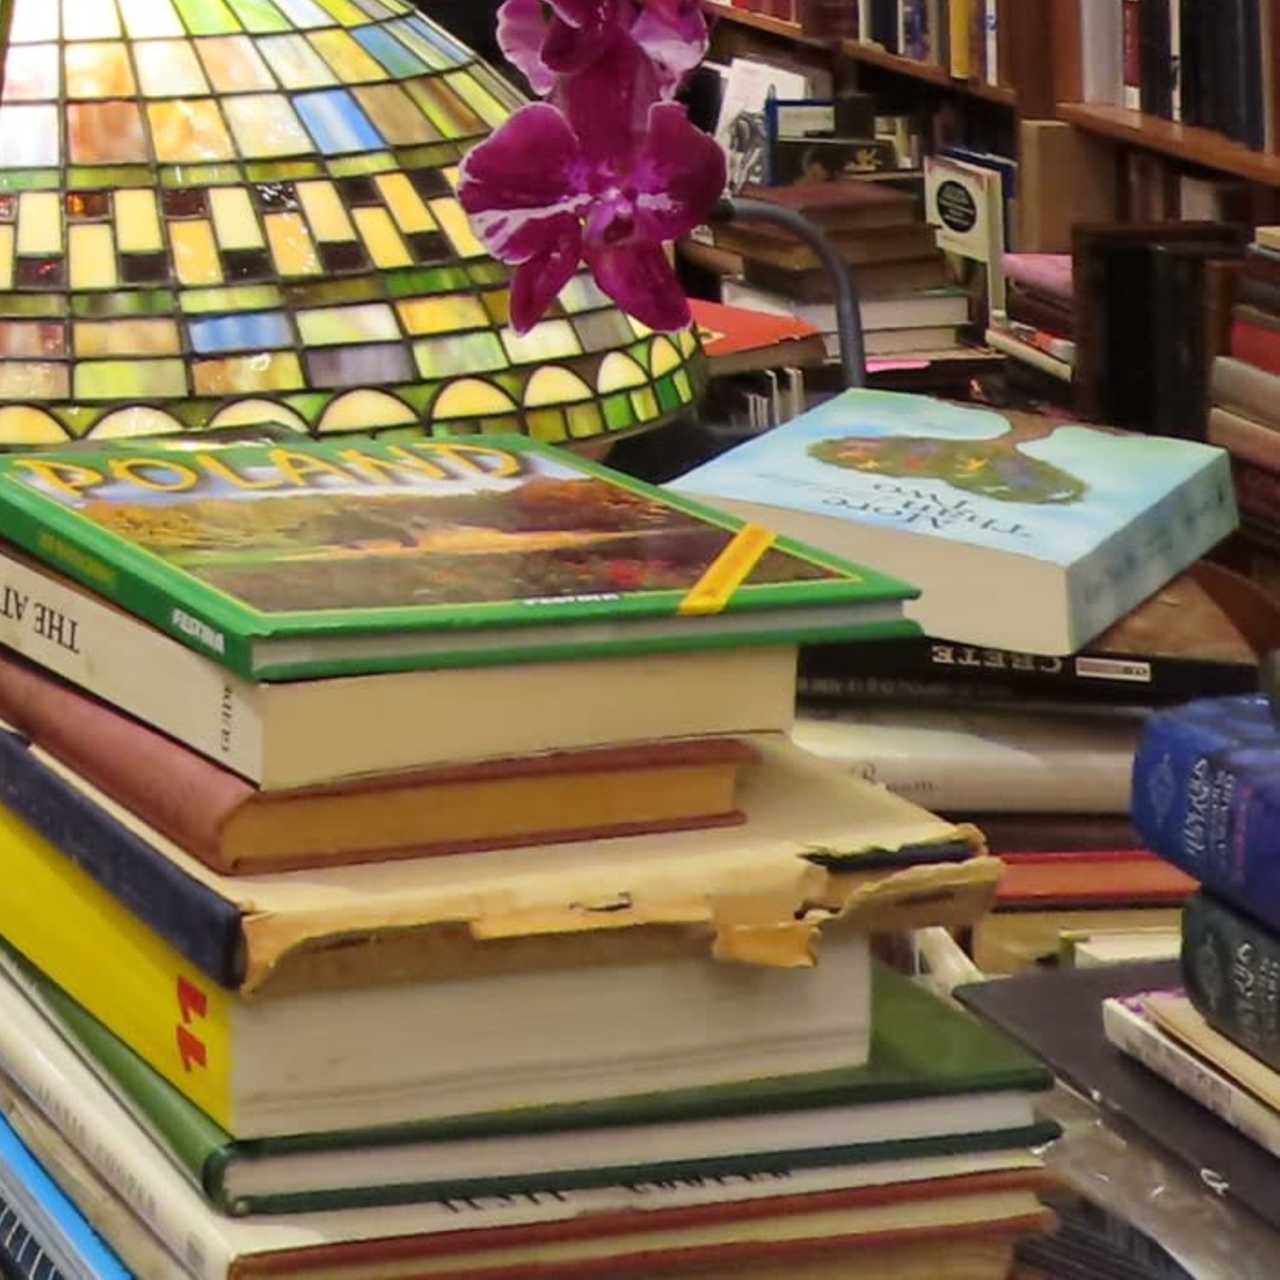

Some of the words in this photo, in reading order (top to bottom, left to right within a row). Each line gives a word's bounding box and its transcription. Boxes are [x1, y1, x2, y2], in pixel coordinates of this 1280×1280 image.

[13, 443, 525, 496] POLAND
[33, 604, 81, 654] THE
[930, 644, 1062, 674] CRETE
